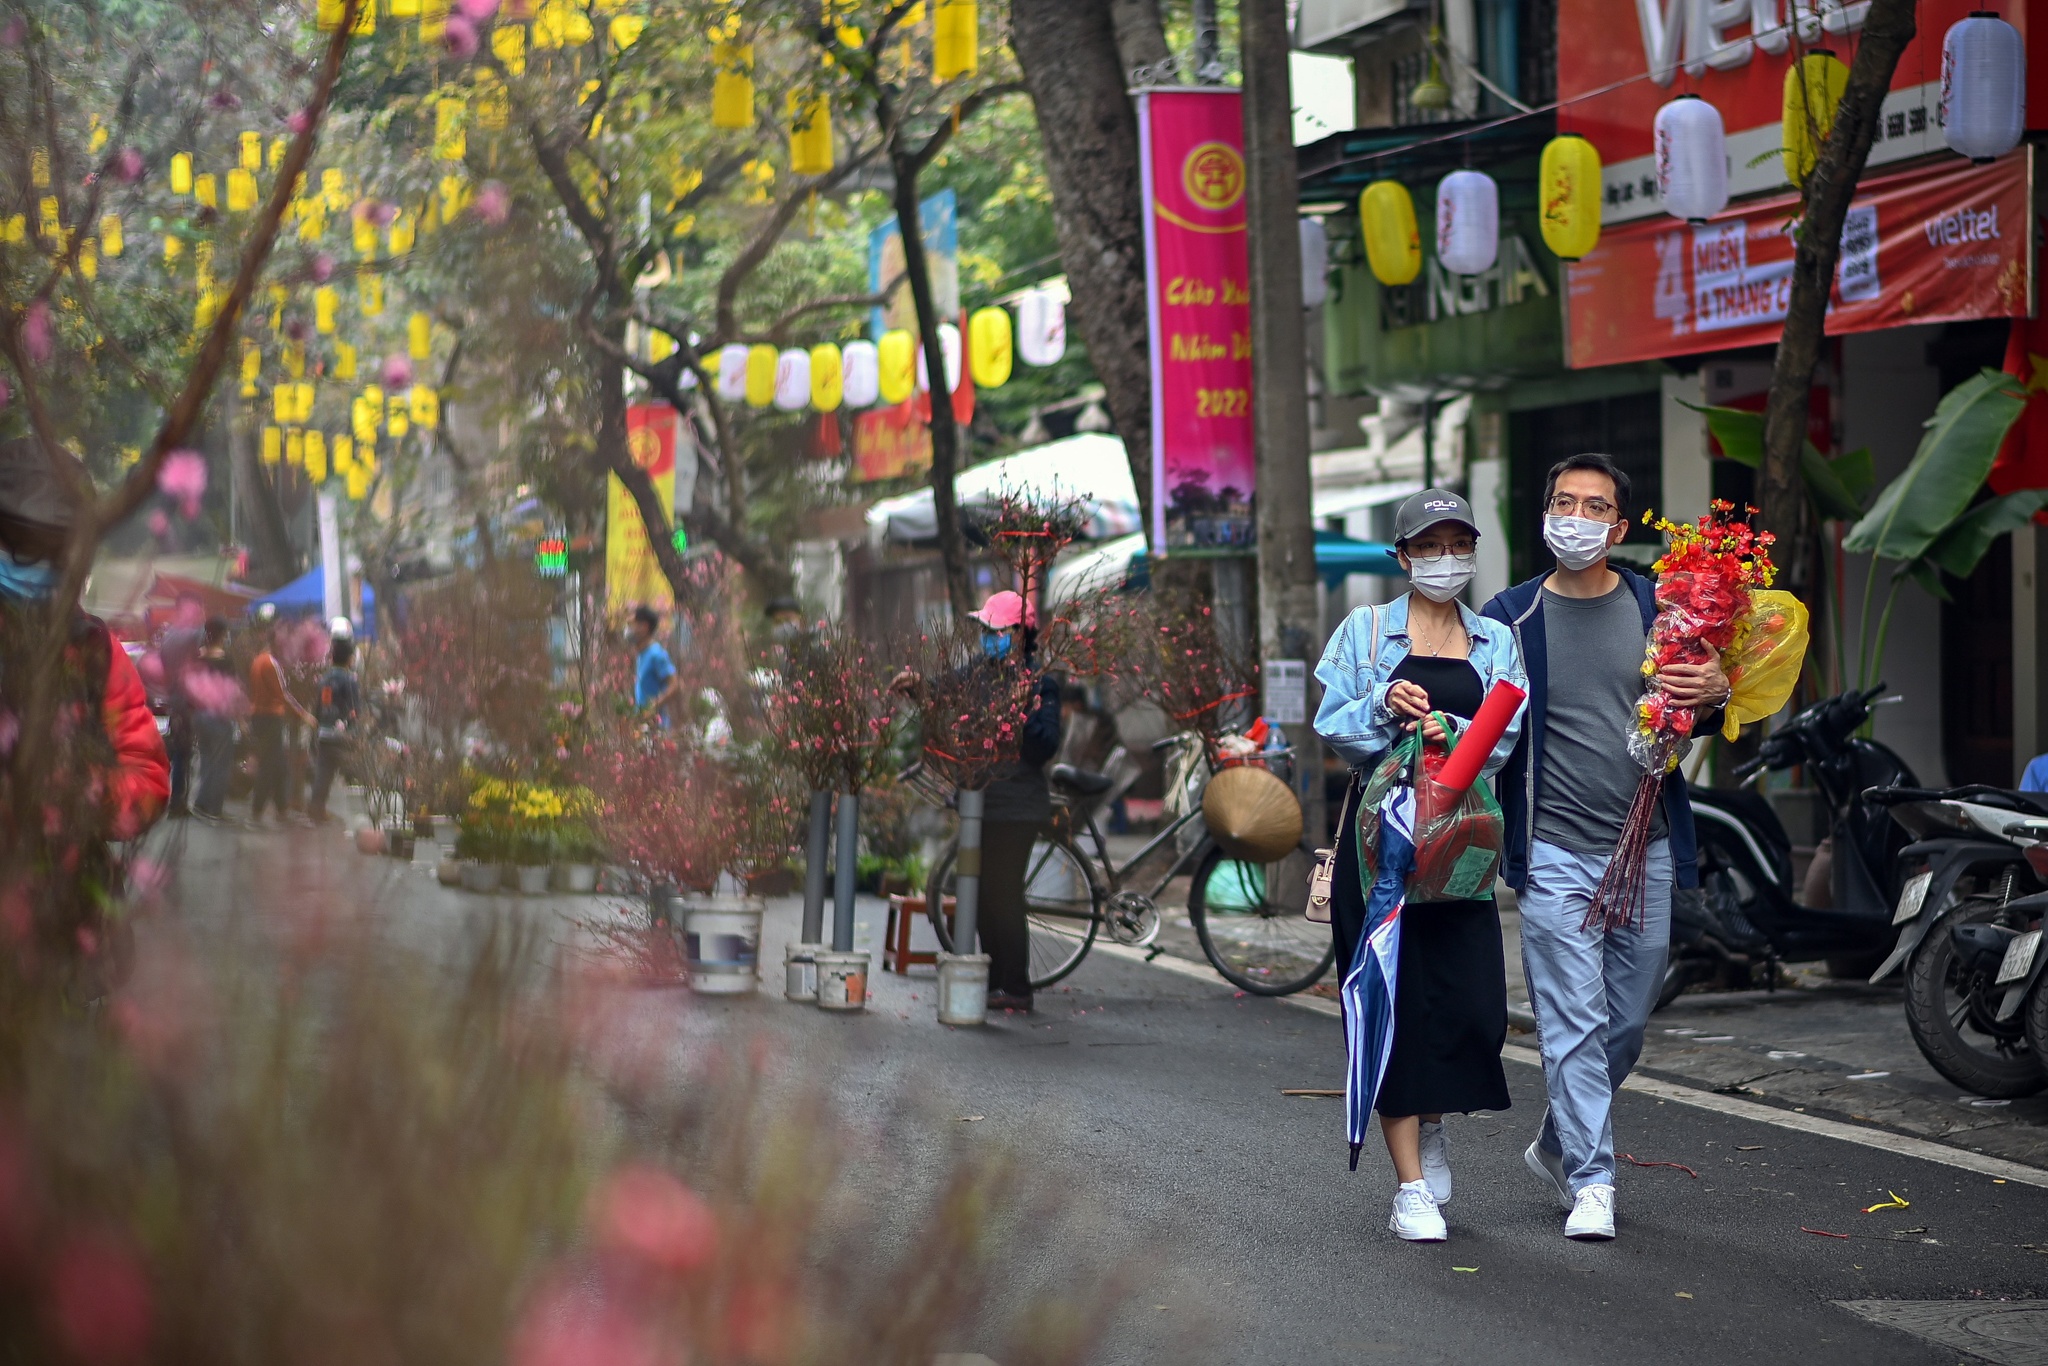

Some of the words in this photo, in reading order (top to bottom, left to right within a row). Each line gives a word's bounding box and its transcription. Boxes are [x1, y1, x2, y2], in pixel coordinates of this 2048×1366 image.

[1925, 204, 2000, 247] viettel
[1197, 388, 1248, 418] 2022
[1424, 500, 1457, 509] POLO
